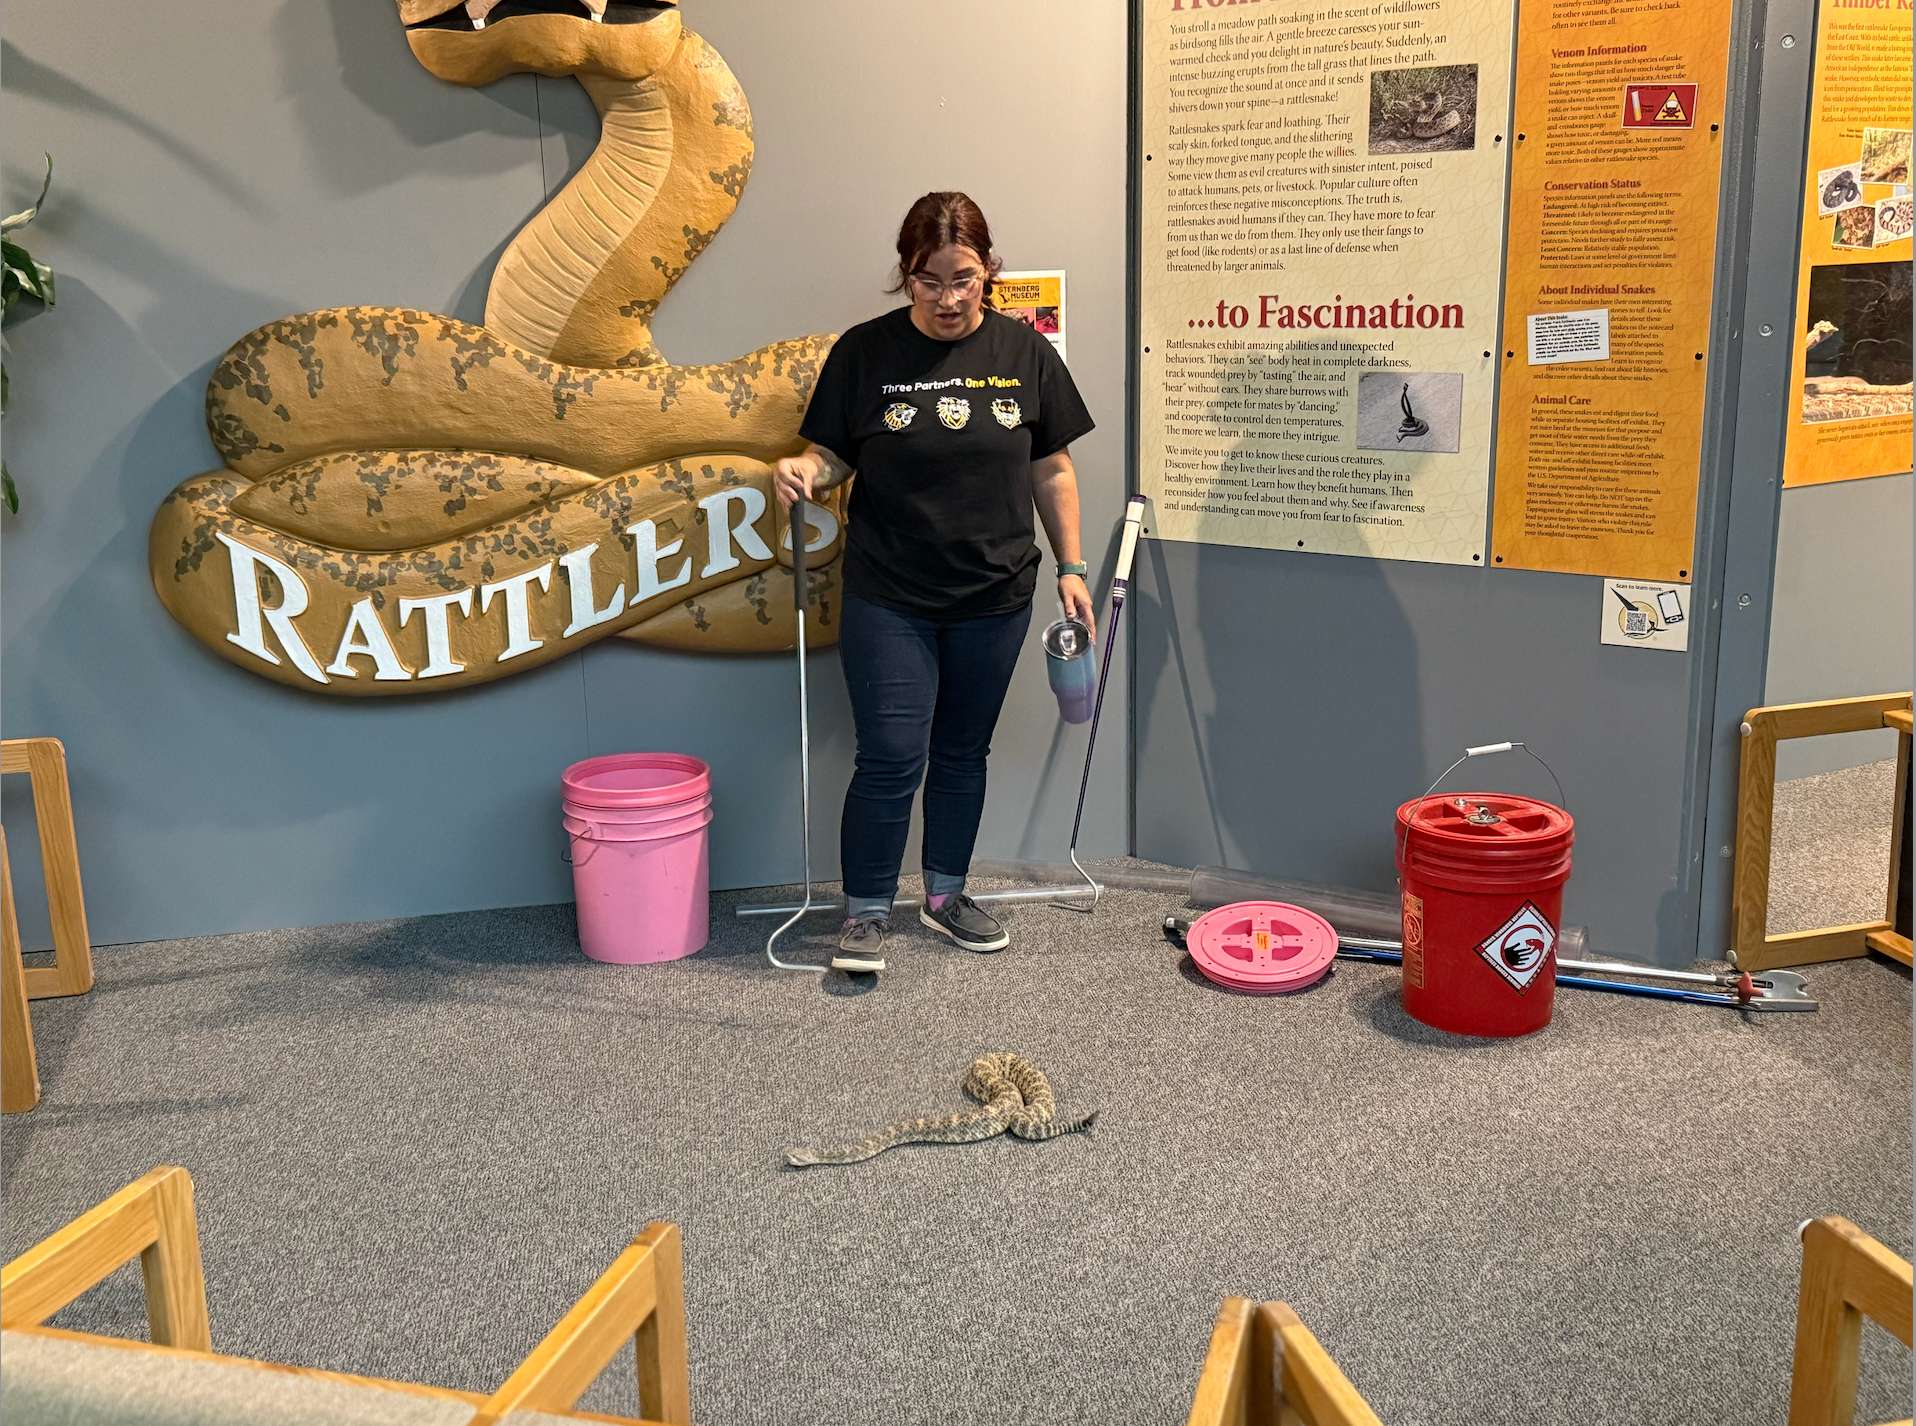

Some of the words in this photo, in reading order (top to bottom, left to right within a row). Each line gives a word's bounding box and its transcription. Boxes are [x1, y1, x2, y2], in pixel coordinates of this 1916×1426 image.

[1170, 24, 1185, 34] You
[1187, 21, 1209, 32] stroll
[1210, 22, 1215, 30] a
[1218, 17, 1255, 29] meadow
[1257, 14, 1276, 28] path
[1279, 12, 1314, 23] soaking
[1316, 11, 1325, 20] in
[1327, 8, 1342, 19] the
[1344, 6, 1368, 17] scent
[1371, 4, 1381, 14] of
[1383, 1, 1440, 13] wildflowers
[1169, 42, 1178, 50] as
[1179, 38, 1217, 49] birdsong
[1218, 35, 1233, 45] fills
[1235, 33, 1249, 44] the
[1266, 31, 1274, 41] A
[1276, 29, 1304, 43] gentle
[1305, 27, 1336, 38] breeze
[1337, 24, 1376, 35] caresses
[1378, 22, 1401, 34] your
[1169, 53, 1204, 65] warmed
[1205, 51, 1230, 62] cheek
[1232, 49, 1249, 60] and
[1251, 50, 1267, 61] you
[1269, 45, 1299, 58] delight
[1302, 45, 1311, 54] in
[1313, 41, 1348, 53] nature's
[1434, 35, 1446, 43] an
[1551, 49, 1585, 58] Venom
[1586, 43, 1646, 55] Information
[1169, 71, 1199, 81] intense
[1201, 68, 1235, 79] buzzing
[1236, 65, 1264, 77] erupts
[1266, 63, 1288, 73] from
[1290, 61, 1305, 71] the
[1307, 59, 1321, 70] tall
[1323, 60, 1347, 71] grass
[1349, 56, 1367, 67] that
[1369, 55, 1392, 65] lines
[1394, 53, 1410, 63] the
[1169, 87, 1184, 97] You
[1187, 84, 1228, 97] recognize
[1230, 82, 1244, 92] the
[1245, 79, 1272, 91] sound
[1274, 79, 1282, 89] at
[1285, 79, 1307, 88] once
[1308, 75, 1326, 86] and
[1328, 75, 1334, 85] it
[1336, 73, 1363, 84] sends
[1168, 102, 1198, 112] shivers
[1198, 100, 1223, 110] down
[1225, 100, 1245, 111] your
[1543, 180, 1608, 190] Conservation
[1609, 179, 1641, 188] Status
[998, 285, 1040, 293] STERNBERG
[1538, 285, 1568, 293] About
[1569, 284, 1619, 293] Individual
[1620, 284, 1656, 293] Snakes
[1258, 294, 1464, 329] Fascination
[1166, 338, 1215, 349] Rattlesnakes
[1216, 339, 1245, 349] exhibit
[1247, 340, 1283, 352] amazing
[1285, 340, 1319, 350] abilities
[1320, 340, 1337, 350] and
[1340, 341, 1393, 353] unexpected
[1208, 354, 1228, 366] They
[1268, 355, 1290, 367] body
[1291, 355, 1310, 365] heat
[1312, 356, 1321, 365] in
[1323, 356, 1366, 368] complete
[1165, 368, 1185, 377] track
[1187, 368, 1225, 378] wounded
[1227, 371, 1246, 381] prey
[1247, 369, 1257, 382] by
[1297, 370, 1312, 380] the
[1328, 371, 1345, 381] and
[881, 384, 912, 394] Three
[914, 377, 963, 391] Partners.
[965, 377, 985, 388] One
[987, 376, 1021, 388] Vision.
[1187, 383, 1219, 393] without
[1241, 384, 1263, 396] They
[1264, 384, 1288, 395] share
[1289, 385, 1326, 396] burrows
[1328, 386, 1348, 396] with
[1165, 396, 1184, 406] their
[1206, 399, 1242, 410] compete
[1244, 398, 1256, 408] for
[1257, 400, 1283, 409] mates
[1284, 400, 1295, 412] by
[1531, 395, 1567, 404] Animal
[1568, 395, 1591, 404] Care
[1164, 410, 1179, 420] and
[1181, 412, 1221, 423] cooperate
[1223, 413, 1231, 422] to
[1233, 414, 1263, 423] control
[1265, 414, 1281, 424] den
[1166, 424, 1180, 434] The
[1181, 427, 1203, 435] more
[1204, 428, 1216, 436] we
[1242, 428, 1256, 438] the
[1258, 431, 1280, 439] more
[1282, 429, 1301, 442] they
